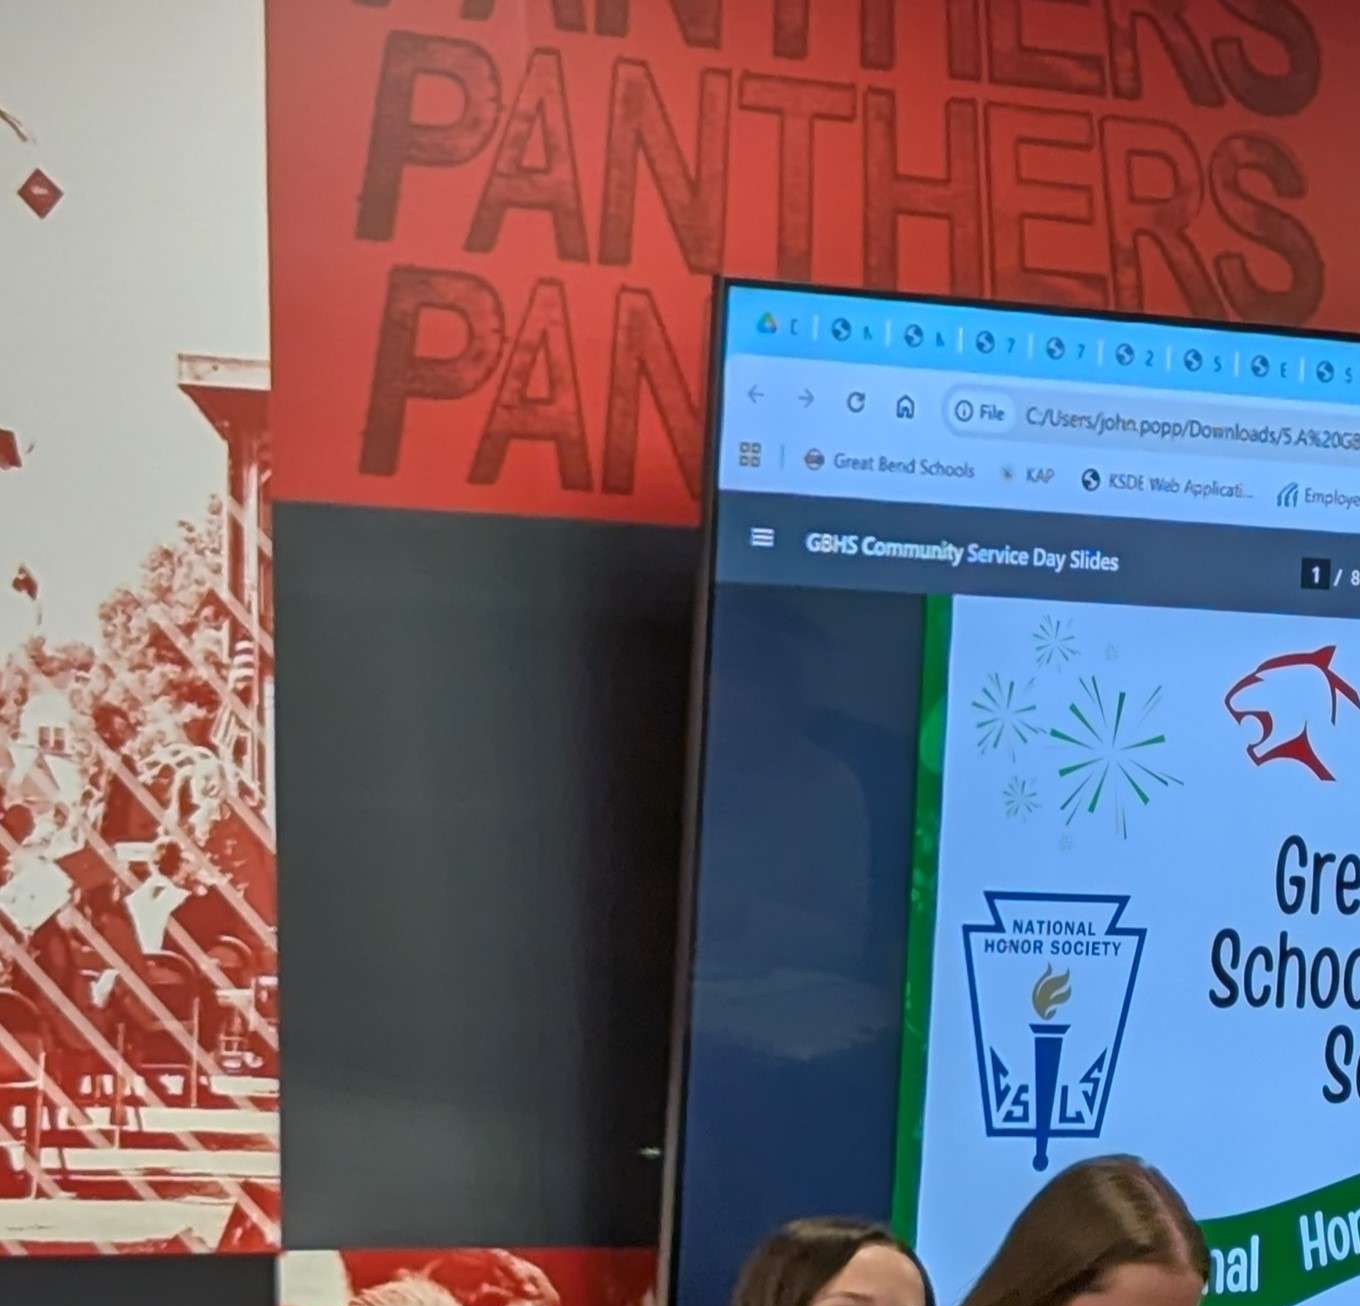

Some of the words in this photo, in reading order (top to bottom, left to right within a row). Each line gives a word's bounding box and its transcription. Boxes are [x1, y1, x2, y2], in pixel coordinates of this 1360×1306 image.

[355, 28, 1325, 325] PANTHERS
[356, 263, 706, 499] PAN
[980, 404, 1005, 421] File
[833, 452, 874, 473] Great
[879, 455, 916, 475] Bend
[920, 458, 976, 479] Schools
[1026, 467, 1056, 484] KAP
[1109, 472, 1145, 491] KSDE
[1150, 476, 1180, 493] Web
[805, 531, 858, 555] GBHS
[860, 535, 965, 568] Community
[966, 543, 1029, 566] Service
[1032, 547, 1066, 573] Day
[1069, 549, 1120, 572] Slides
[1311, 565, 1320, 584] 1
[1350, 569, 1360, 587] 8
[1012, 918, 1096, 937] NATIONAL
[984, 938, 1043, 956] HONOR
[1050, 939, 1122, 957] SOCIETY
[1201, 1234, 1260, 1296] nal
